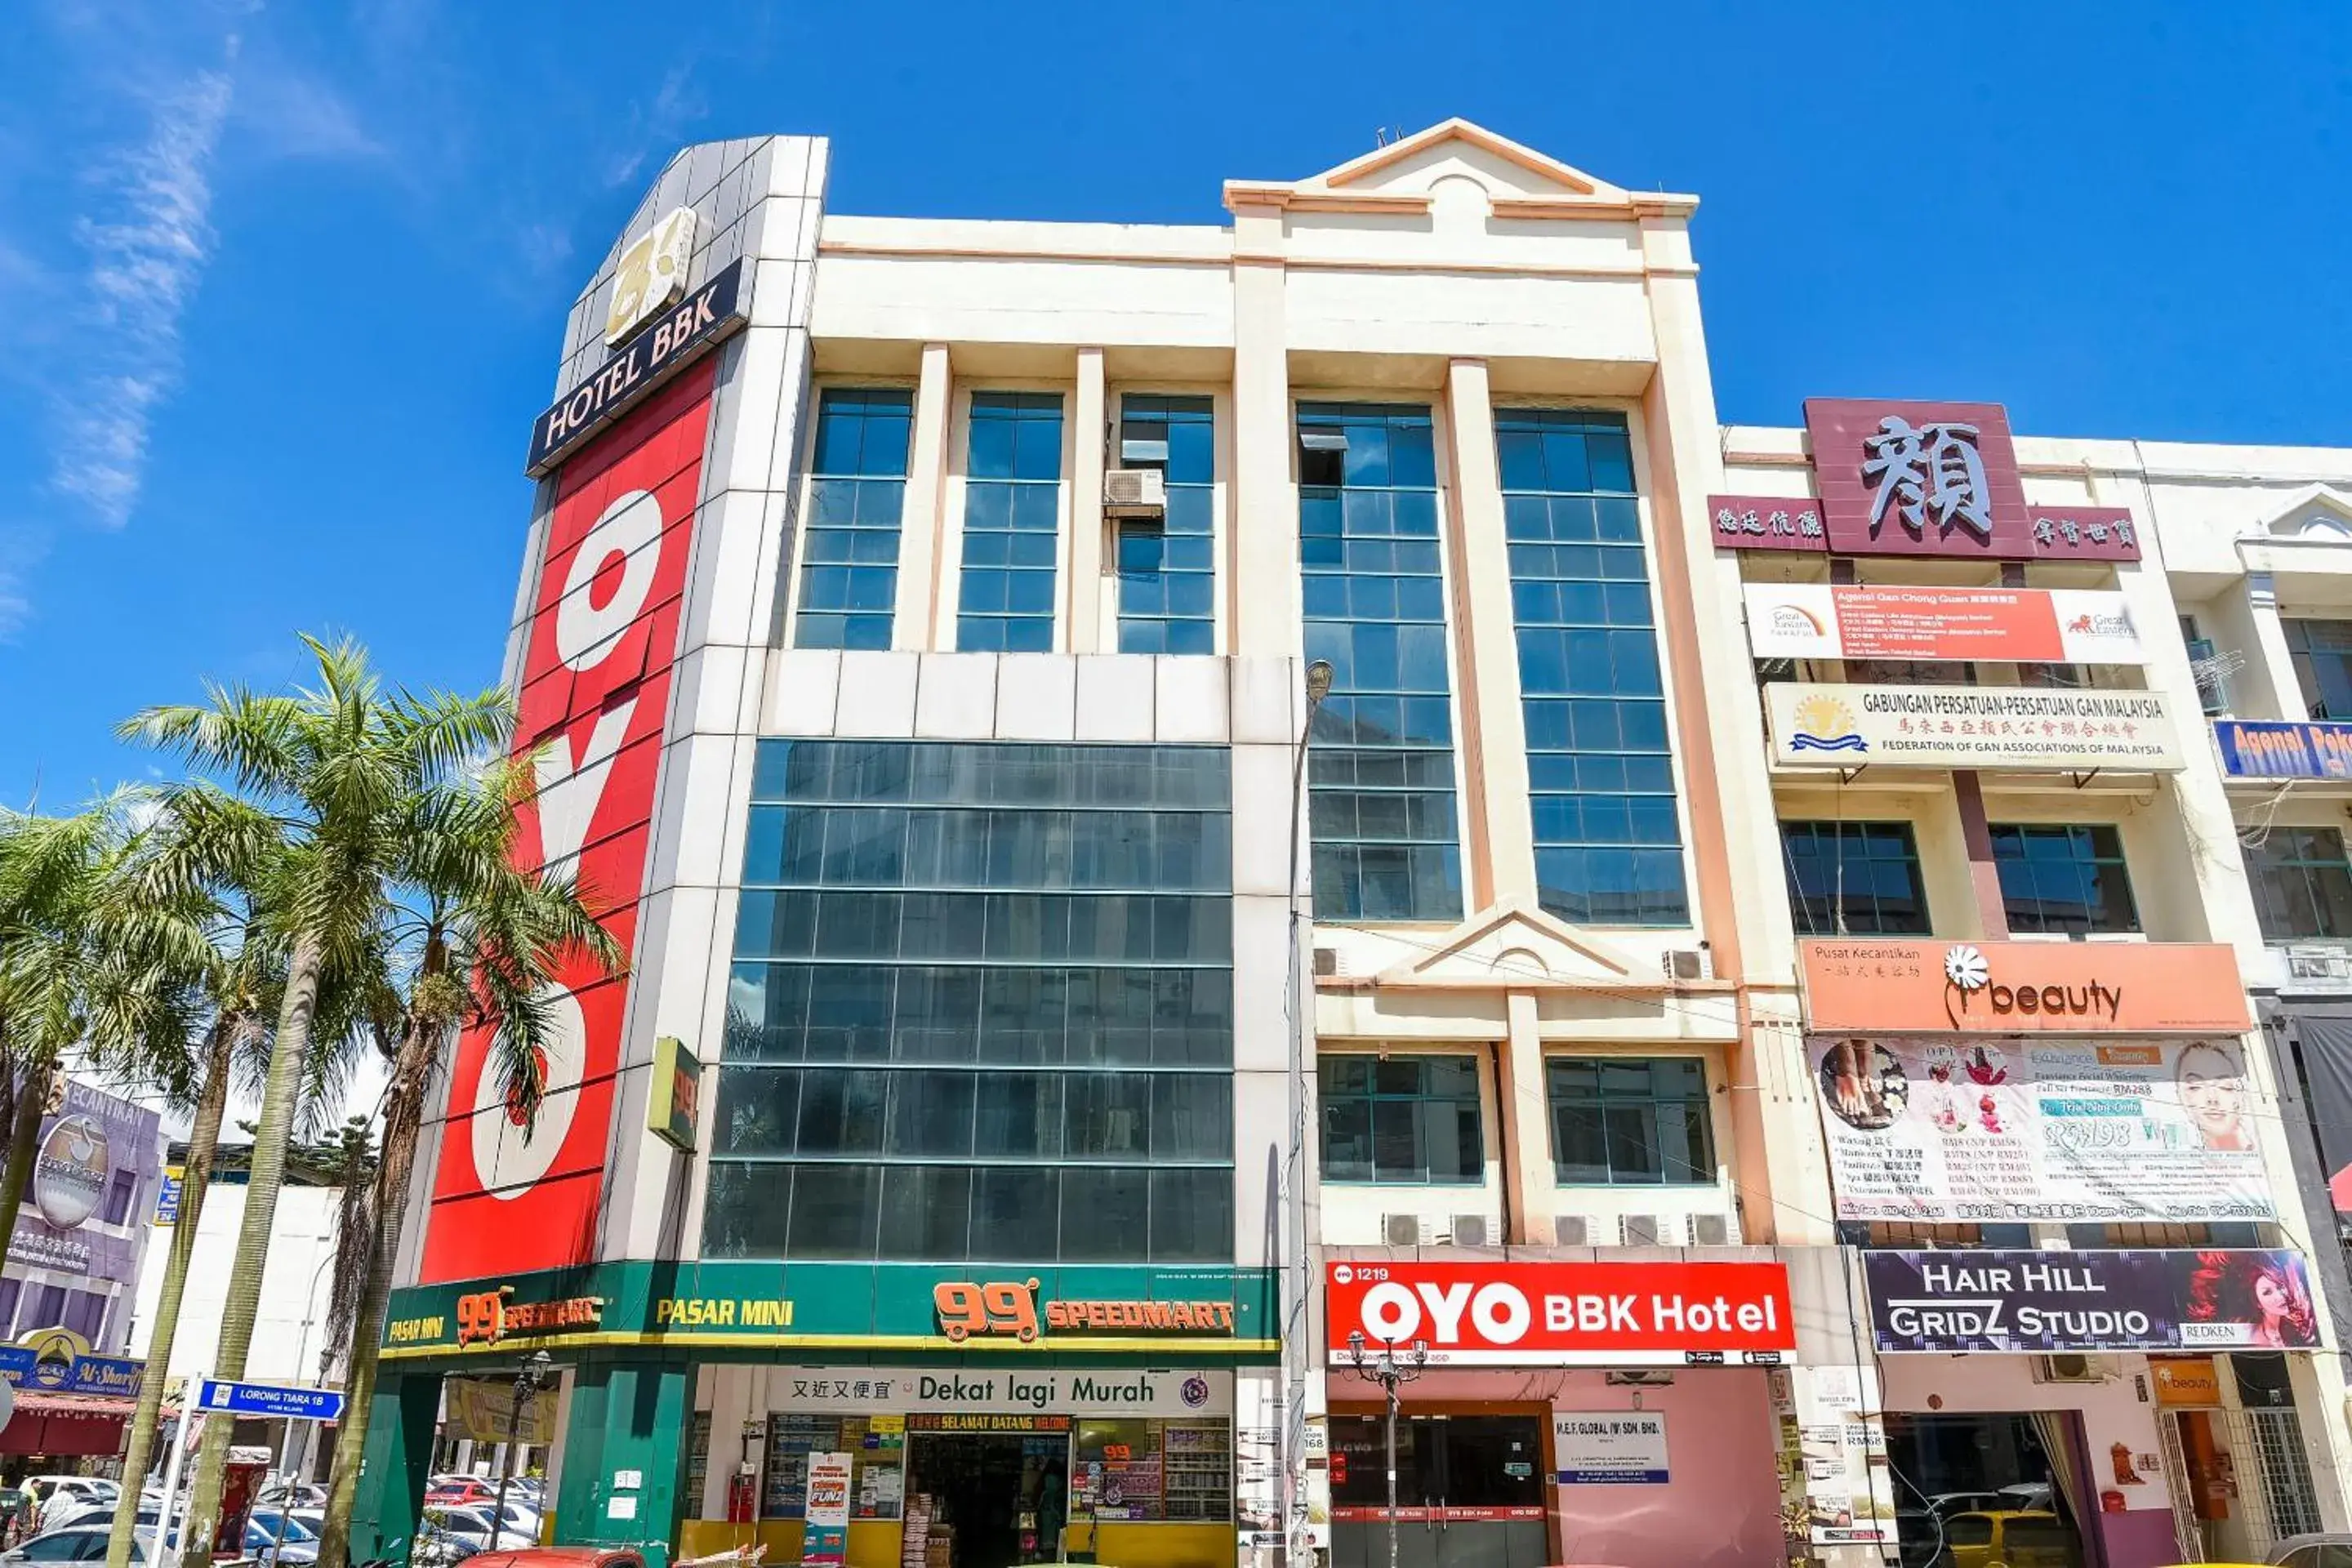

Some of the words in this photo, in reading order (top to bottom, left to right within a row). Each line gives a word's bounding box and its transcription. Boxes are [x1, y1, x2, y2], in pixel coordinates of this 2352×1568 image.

[545, 347, 642, 450] HOTEL
[651, 285, 718, 366] BBK
[1863, 693, 1933, 713] GABUNGAN
[1934, 694, 2075, 716] PERSATUAN-PERSATUAN
[2077, 697, 2102, 717] GAN
[2104, 698, 2164, 719] MALAYSIA
[1882, 740, 1954, 751] FEDERATION
[1958, 742, 1971, 751] OF
[1975, 742, 2000, 752] GAN
[2003, 742, 2087, 754] ASSOCIATIONS
[2089, 744, 2105, 753] OF
[2107, 744, 2164, 755] MALAYSIA
[1815, 947, 1850, 960] Pusat
[1852, 947, 1920, 960] Kecantikan
[1988, 978, 2121, 1022] beauty
[1356, 1268, 1389, 1281] 1219
[1922, 1264, 2015, 1292] HAIR
[2021, 1263, 2106, 1293] HILL
[457, 1285, 514, 1349] 99
[657, 1299, 735, 1325] PASAR
[740, 1300, 794, 1325] MINI
[933, 1277, 1040, 1343] 99
[1045, 1301, 1234, 1330] SPEEDMART
[1361, 1281, 1531, 1345] OYO
[1544, 1294, 1642, 1333] BBK
[1651, 1294, 1777, 1333] Hotel
[1887, 1298, 2010, 1337] GRIDZ
[2016, 1307, 2149, 1336] STUDIO
[389, 1318, 421, 1343] PASAR
[420, 1316, 445, 1339] MINI
[2186, 1325, 2235, 1339] REDKEN
[240, 1389, 281, 1402] LORONG
[283, 1392, 310, 1405] TIARA
[312, 1396, 324, 1406] 1B
[791, 1379, 890, 1400] 又近又便宜
[919, 1374, 994, 1403] Dekat
[1007, 1374, 1056, 1408] lagi
[1071, 1375, 1155, 1403] Murah
[941, 1415, 991, 1430] SELAMAT
[991, 1416, 1033, 1430] DATANG
[1579, 1422, 1608, 1435] GLOBAL
[1103, 1445, 1130, 1460] 99
